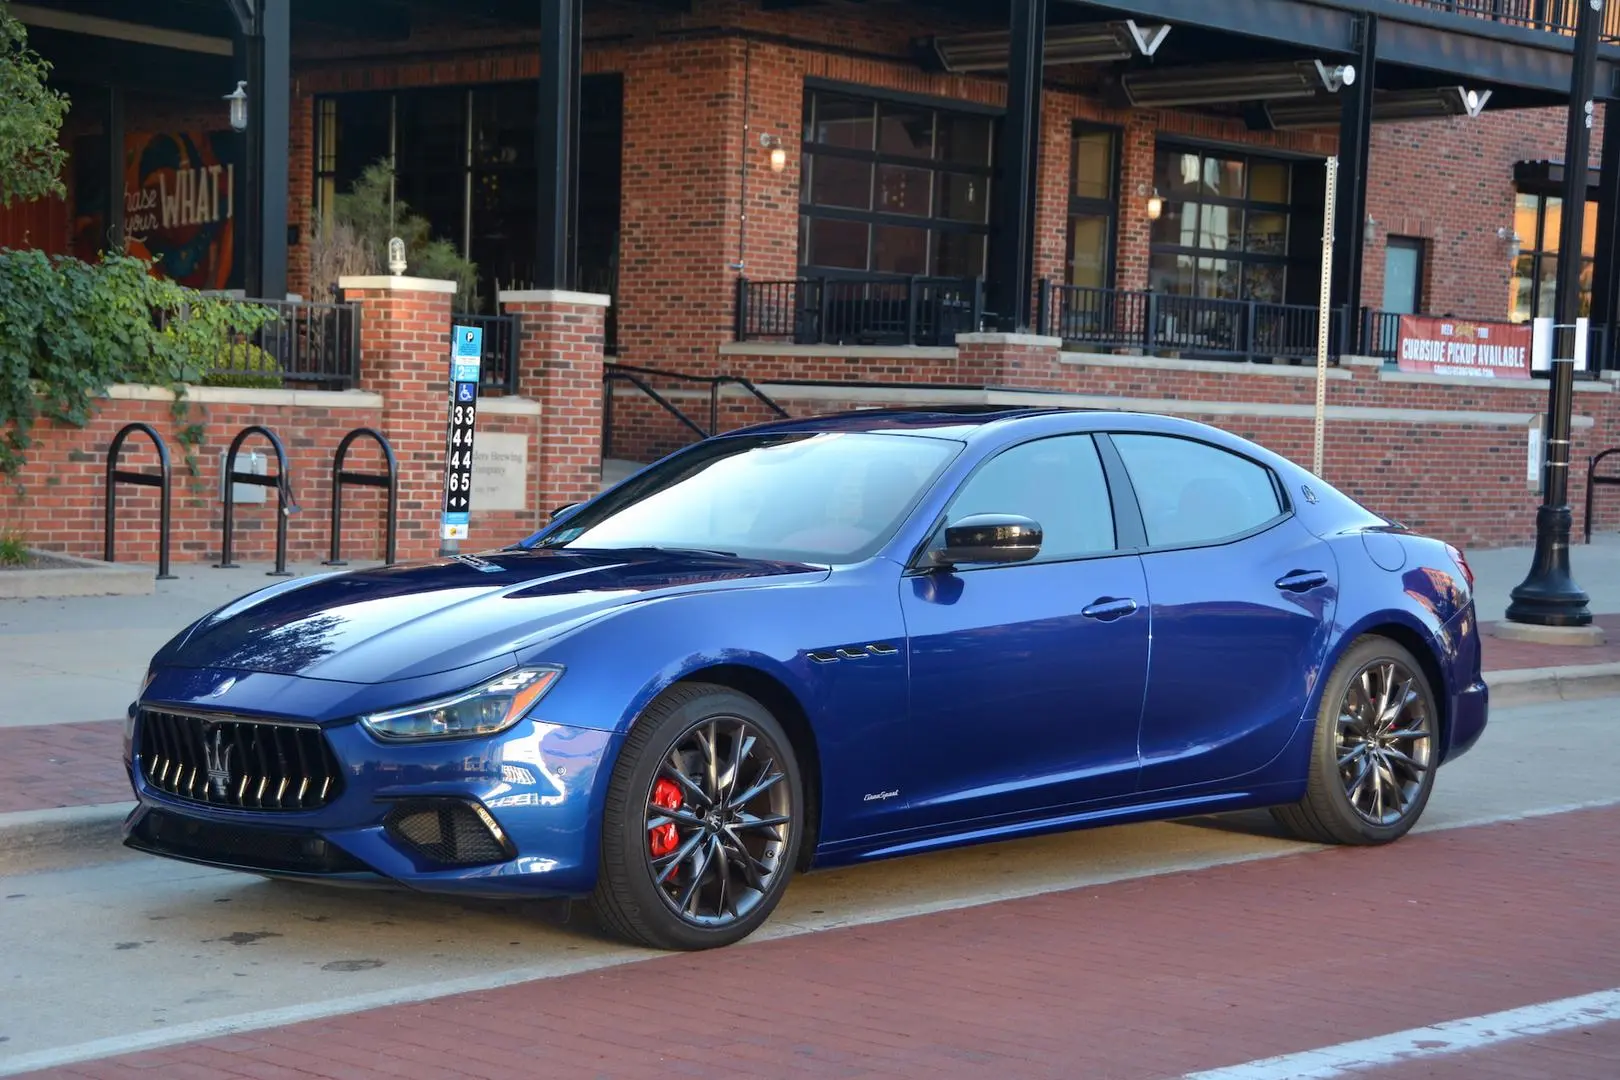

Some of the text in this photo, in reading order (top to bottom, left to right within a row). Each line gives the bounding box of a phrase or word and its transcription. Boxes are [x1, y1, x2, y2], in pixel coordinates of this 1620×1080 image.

[124, 182, 158, 212] hase
[160, 165, 222, 229] WHAT
[1402, 338, 1526, 368] CURBSIDE PICKUP AVAILABLE
